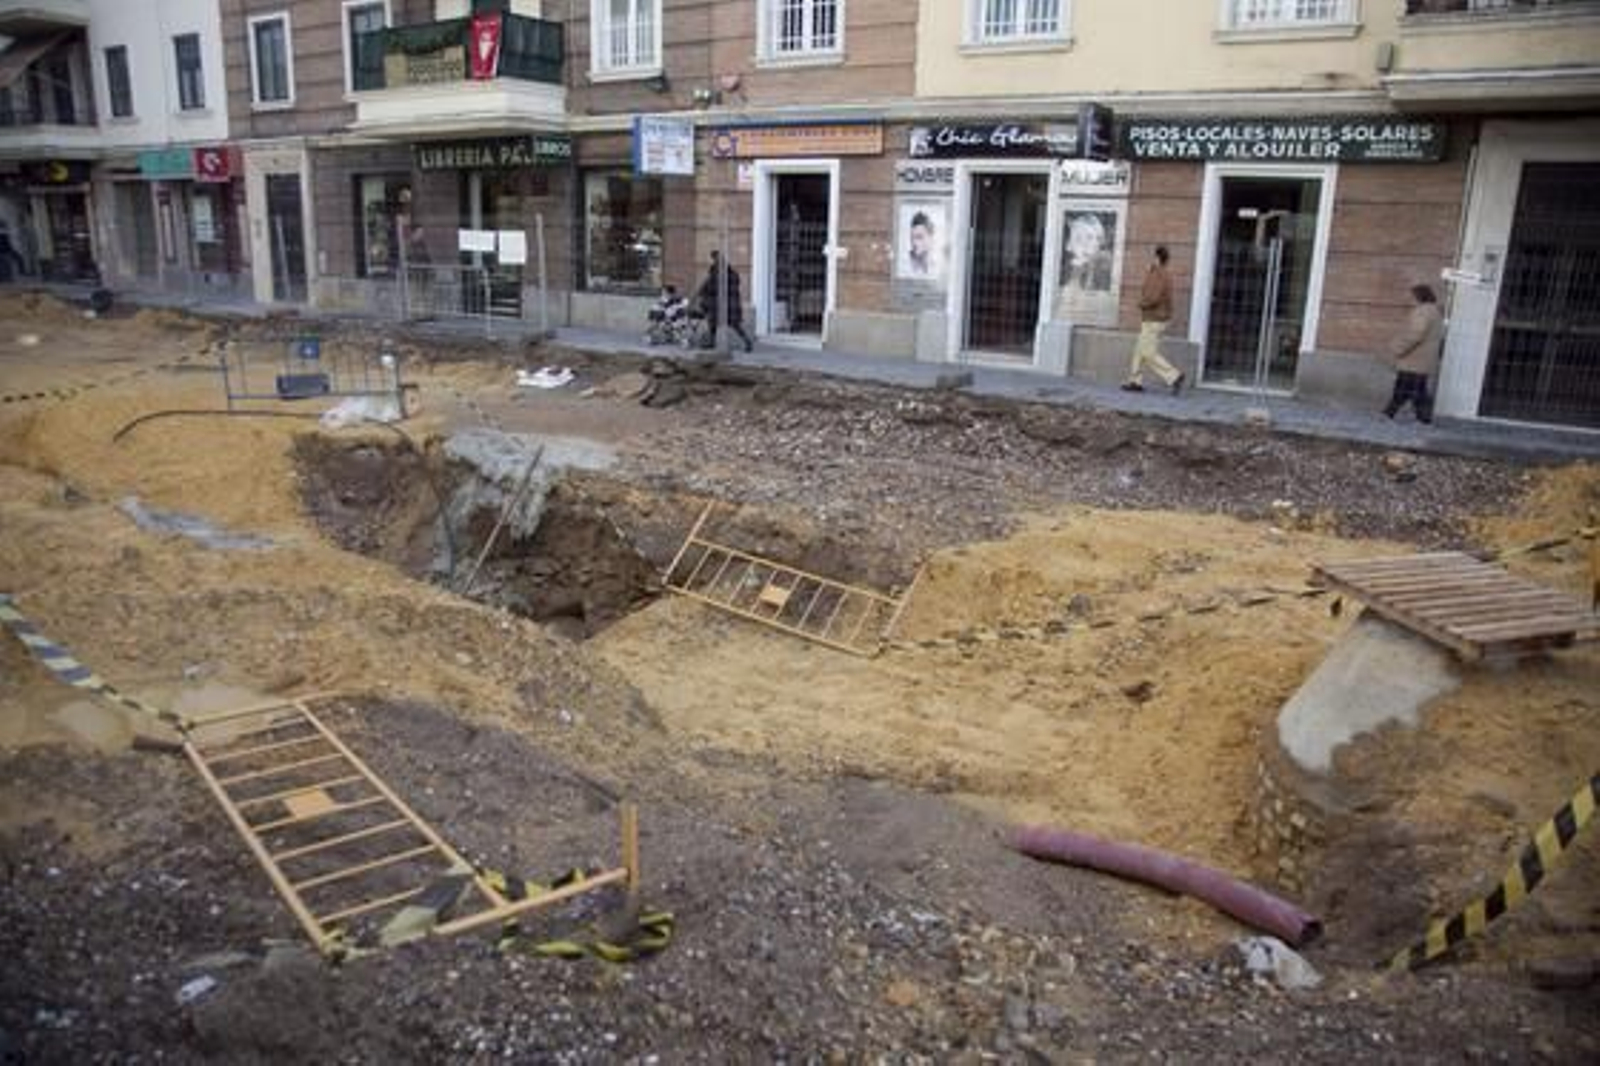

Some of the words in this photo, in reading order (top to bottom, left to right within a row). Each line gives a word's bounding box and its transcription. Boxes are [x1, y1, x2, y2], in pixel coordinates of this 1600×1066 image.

[421, 146, 493, 169] LIBRERIA
[1134, 141, 1201, 157] VENTA
[1206, 142, 1221, 157] Y
[1224, 141, 1341, 158] ALQUILER
[897, 166, 954, 184] HOMBRE
[1061, 168, 1128, 186] MUJER
